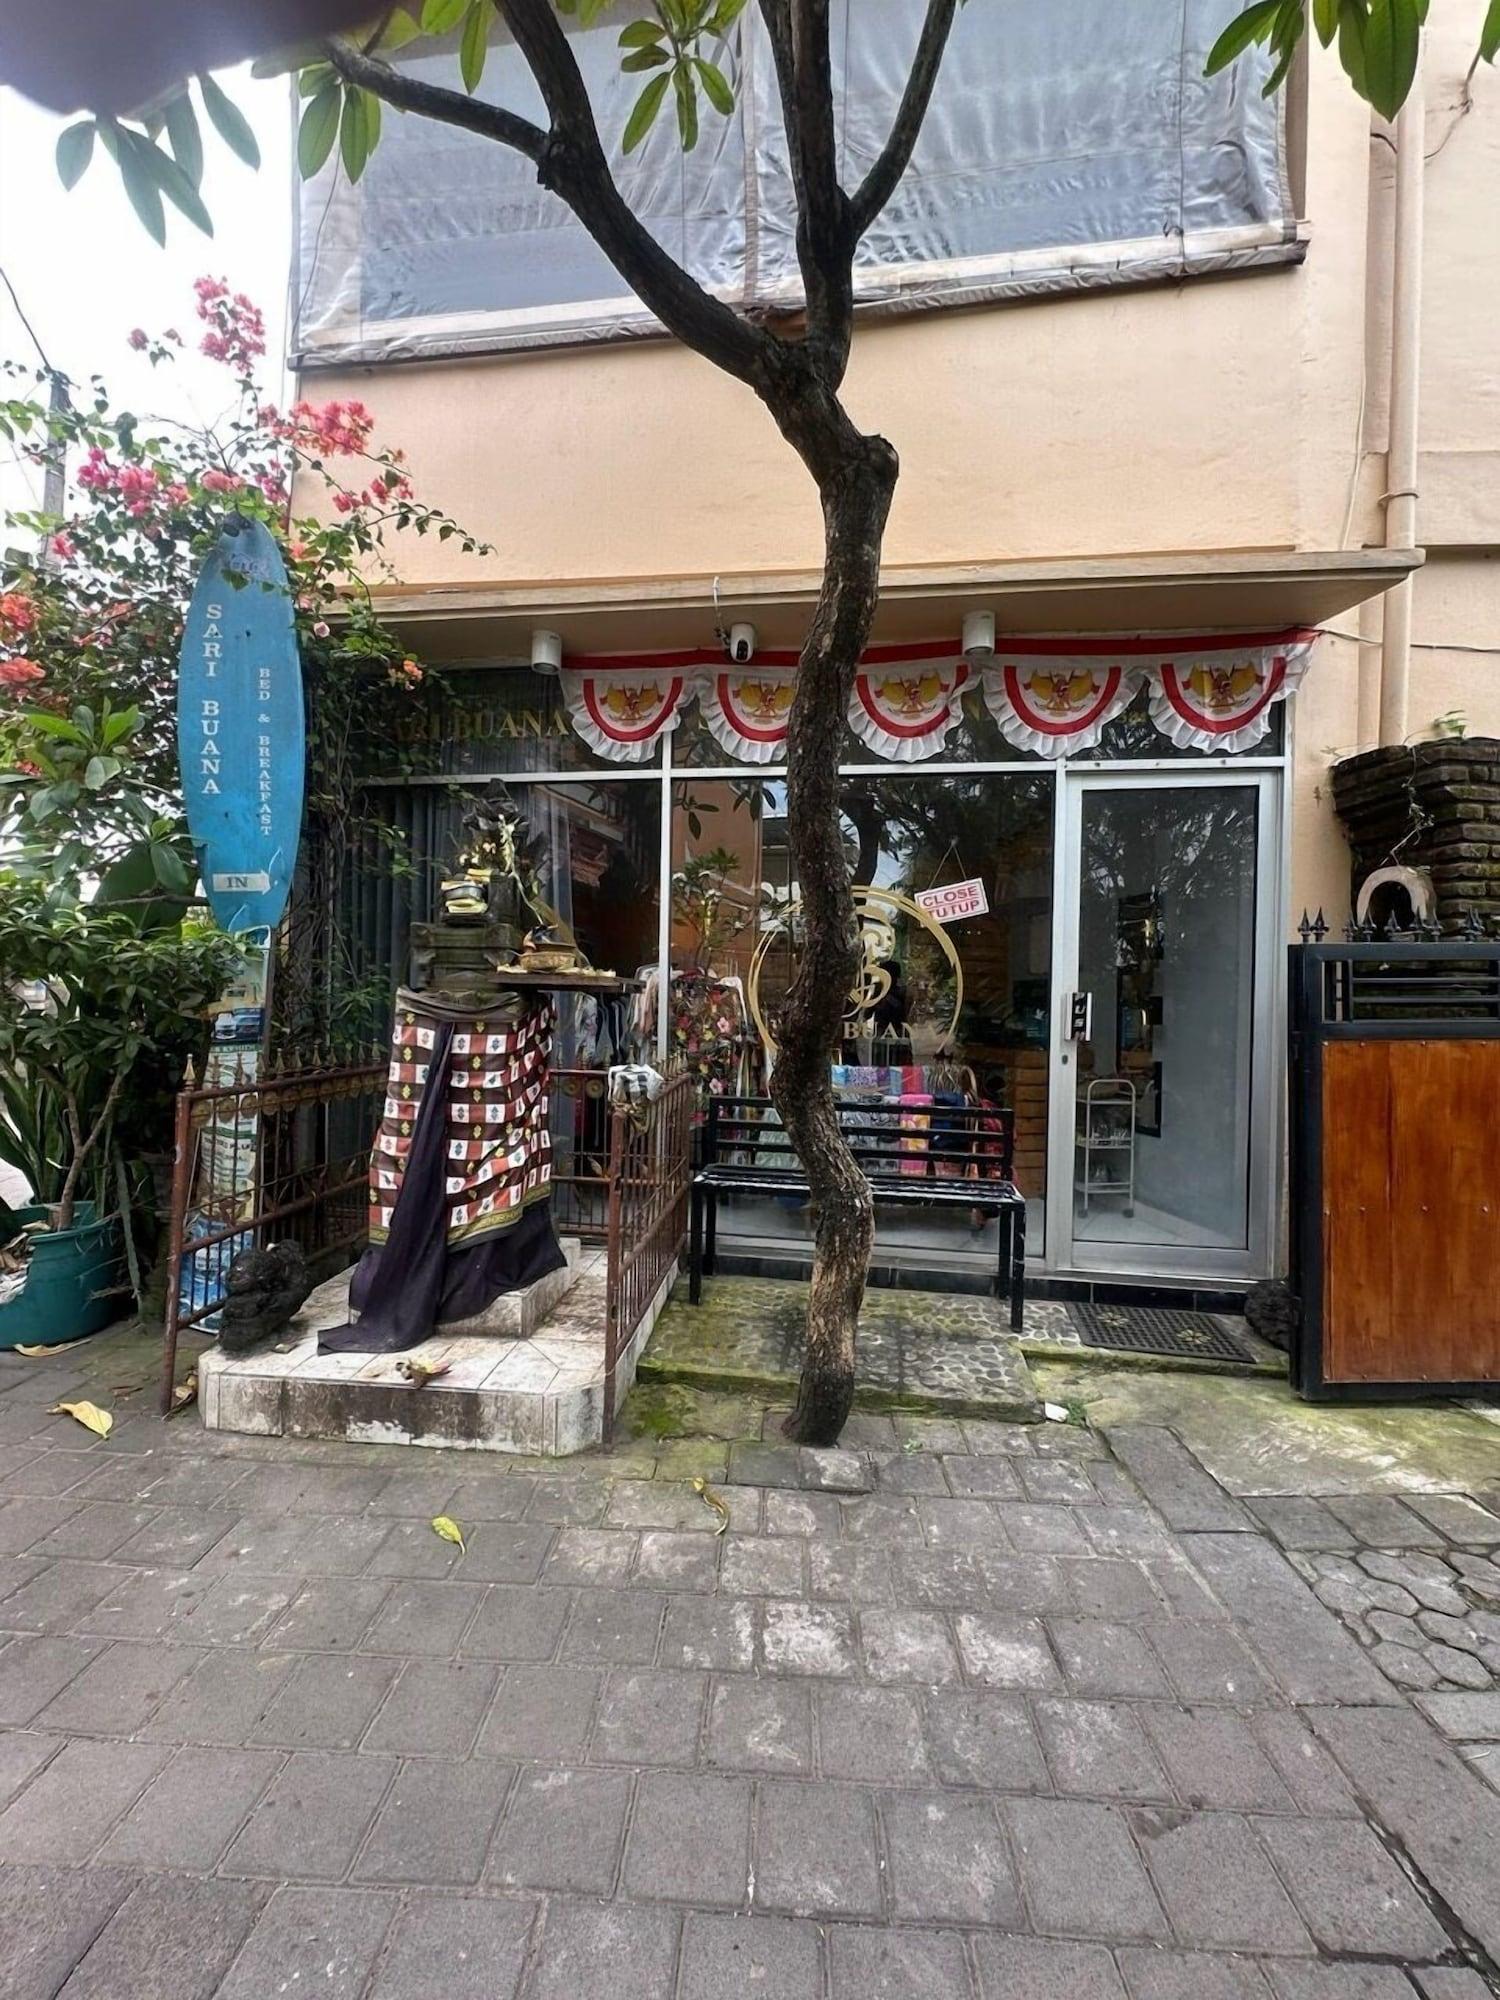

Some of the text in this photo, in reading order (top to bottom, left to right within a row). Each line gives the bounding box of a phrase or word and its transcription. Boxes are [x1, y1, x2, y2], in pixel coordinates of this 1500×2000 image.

[201, 604, 222, 795] SARI BUANA
[452, 709, 570, 738] BUANA
[258, 668, 272, 836] BED & BREAKFAST
[226, 877, 249, 889] IN
[922, 885, 977, 907] CLOSE
[928, 900, 979, 918] TUTUP
